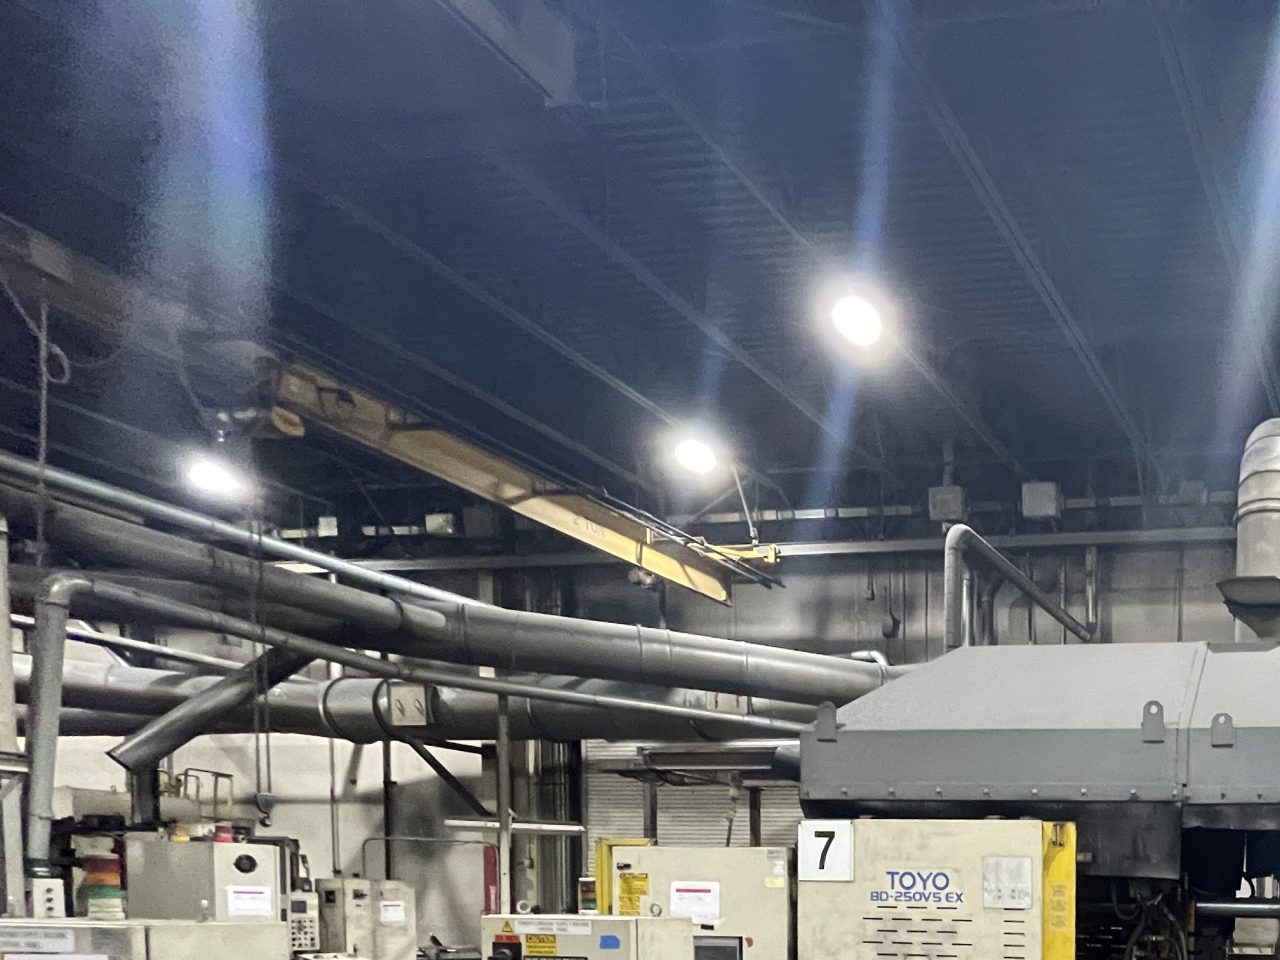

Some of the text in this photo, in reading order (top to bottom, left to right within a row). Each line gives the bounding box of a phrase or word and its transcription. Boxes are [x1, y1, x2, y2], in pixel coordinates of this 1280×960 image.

[814, 830, 836, 870] 7
[886, 871, 950, 891] TOYO
[945, 892, 964, 903] EX
